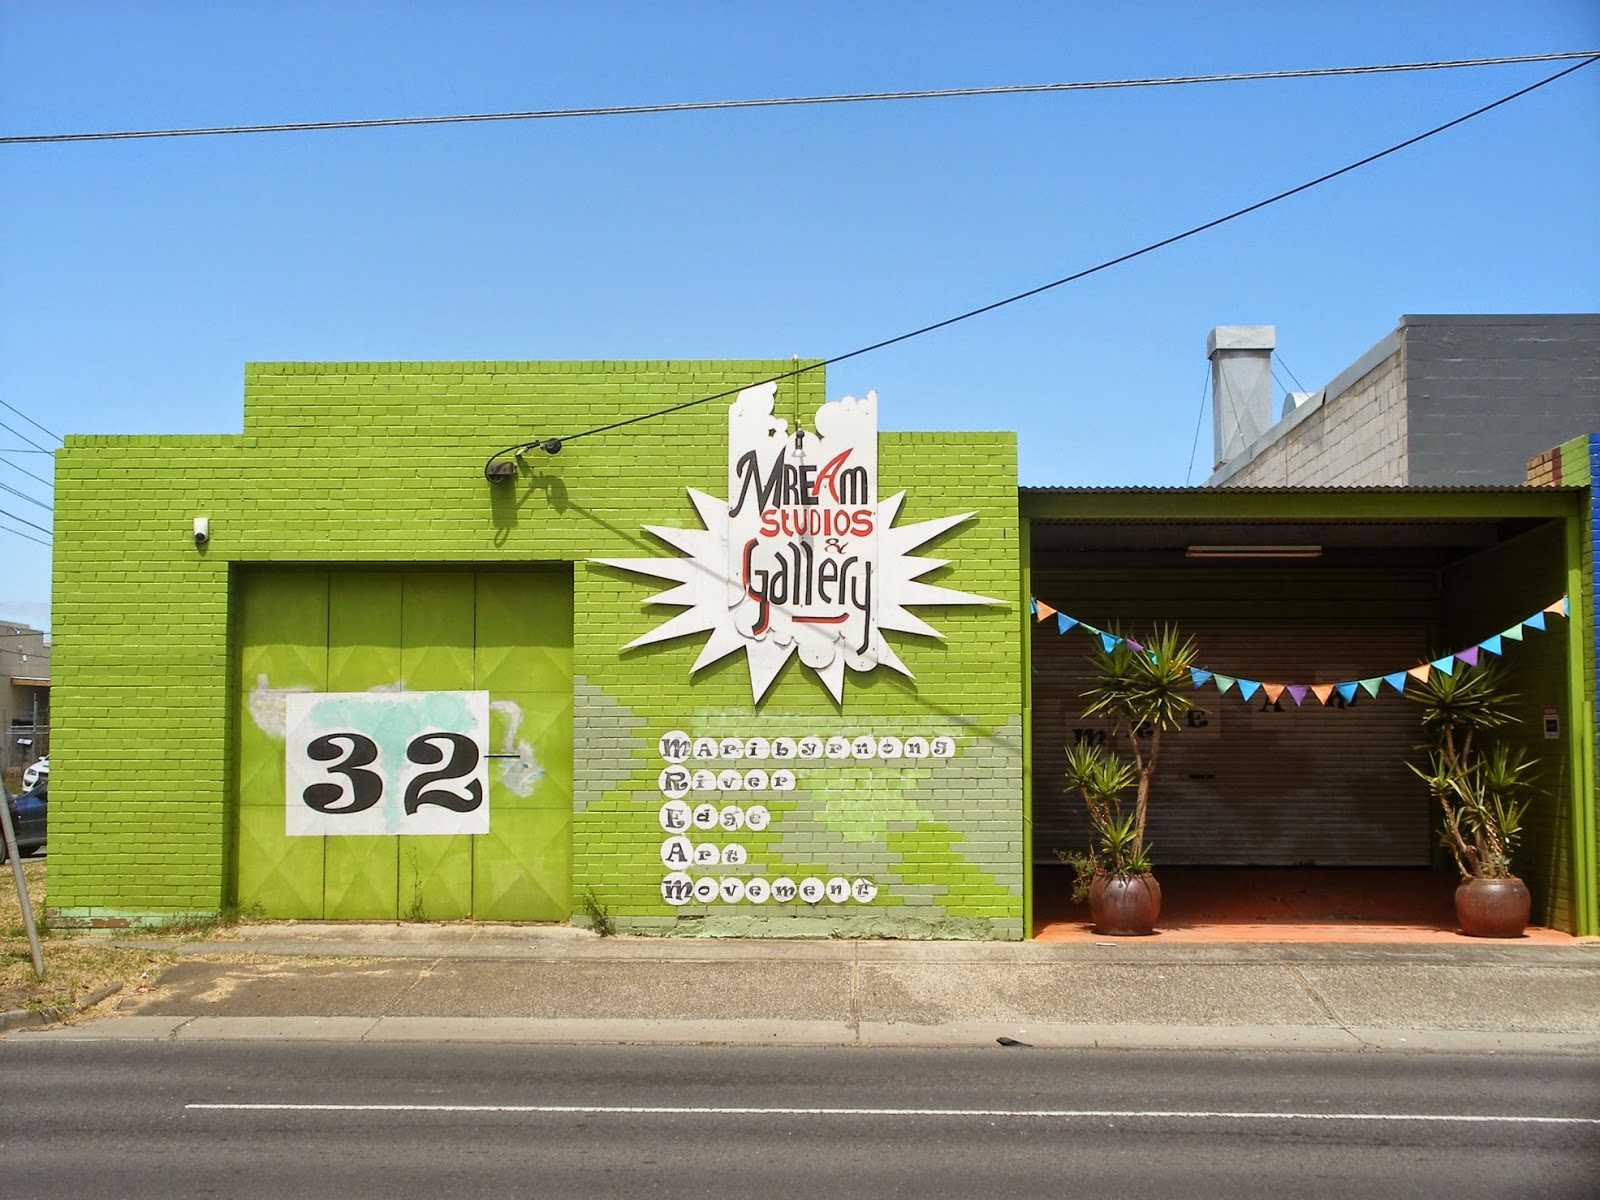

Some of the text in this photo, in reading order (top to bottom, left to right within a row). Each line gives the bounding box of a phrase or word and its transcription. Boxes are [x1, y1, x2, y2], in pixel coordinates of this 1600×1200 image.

[825, 538, 847, 555] &
[743, 538, 871, 656] Gallery
[303, 732, 482, 816] 32
[664, 770, 788, 791] River
[665, 808, 762, 829] Edge
[665, 843, 739, 863] Art
